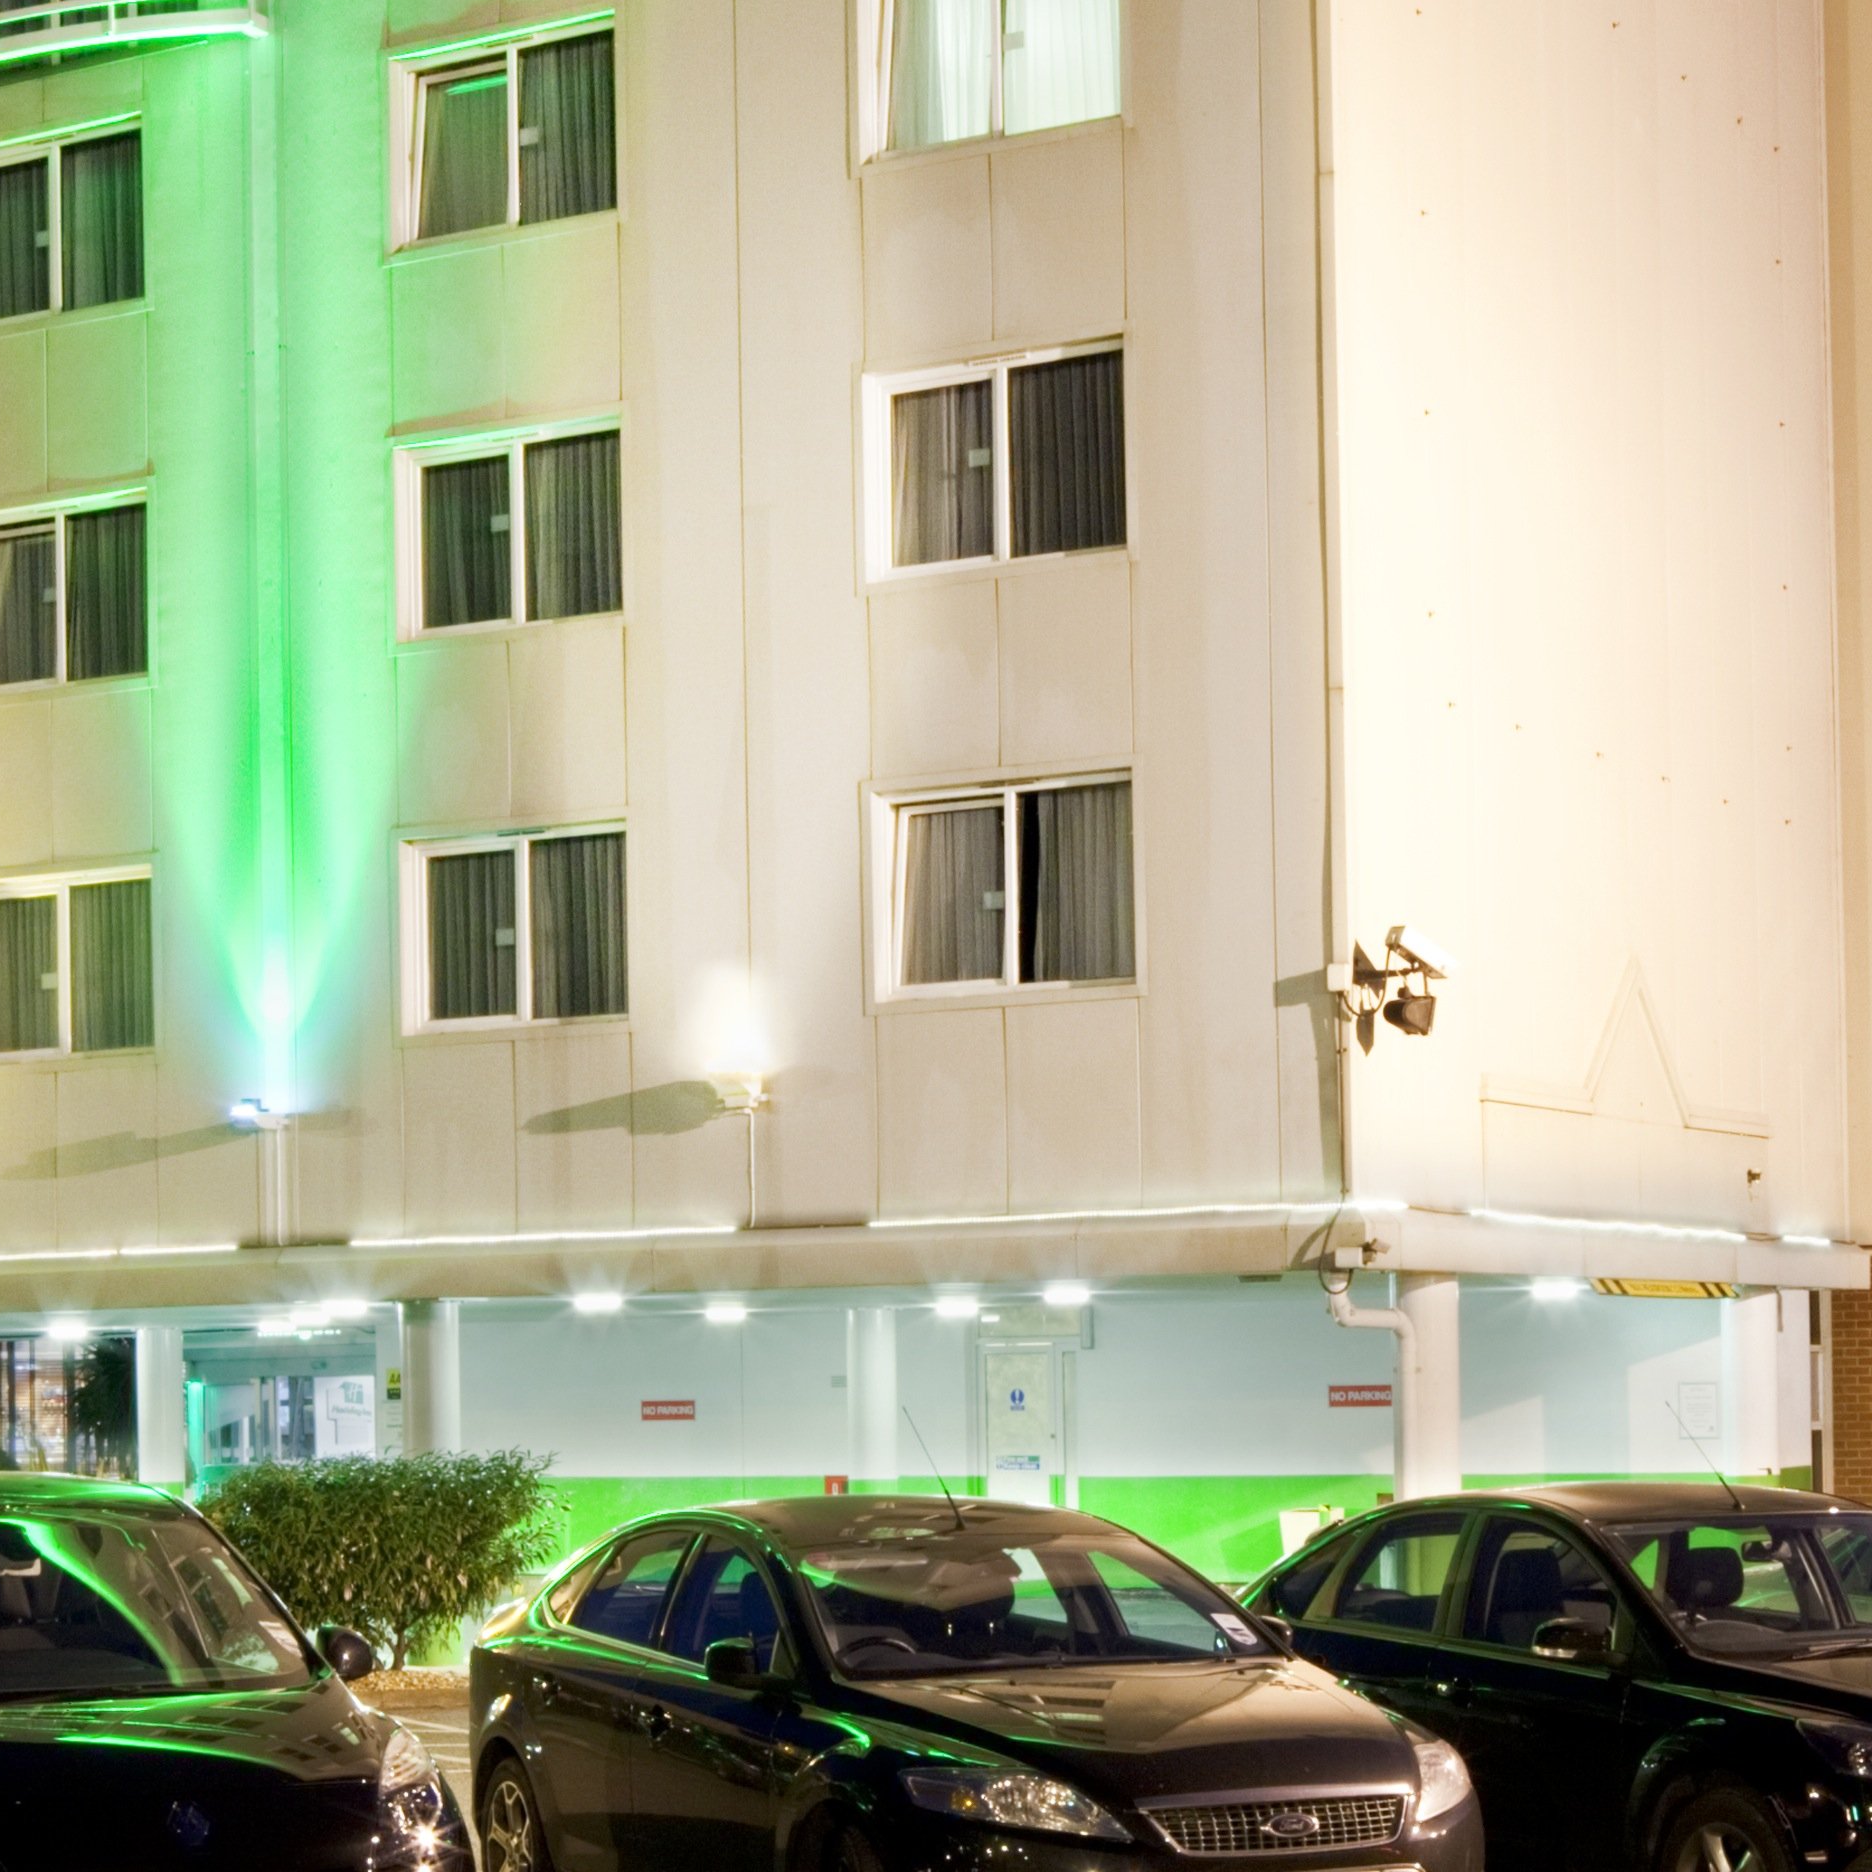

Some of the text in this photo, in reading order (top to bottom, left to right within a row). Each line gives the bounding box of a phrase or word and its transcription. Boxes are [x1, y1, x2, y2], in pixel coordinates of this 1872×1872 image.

[1330, 1390, 1392, 1402] NO PARKING
[643, 1405, 694, 1416] NO PARKING
